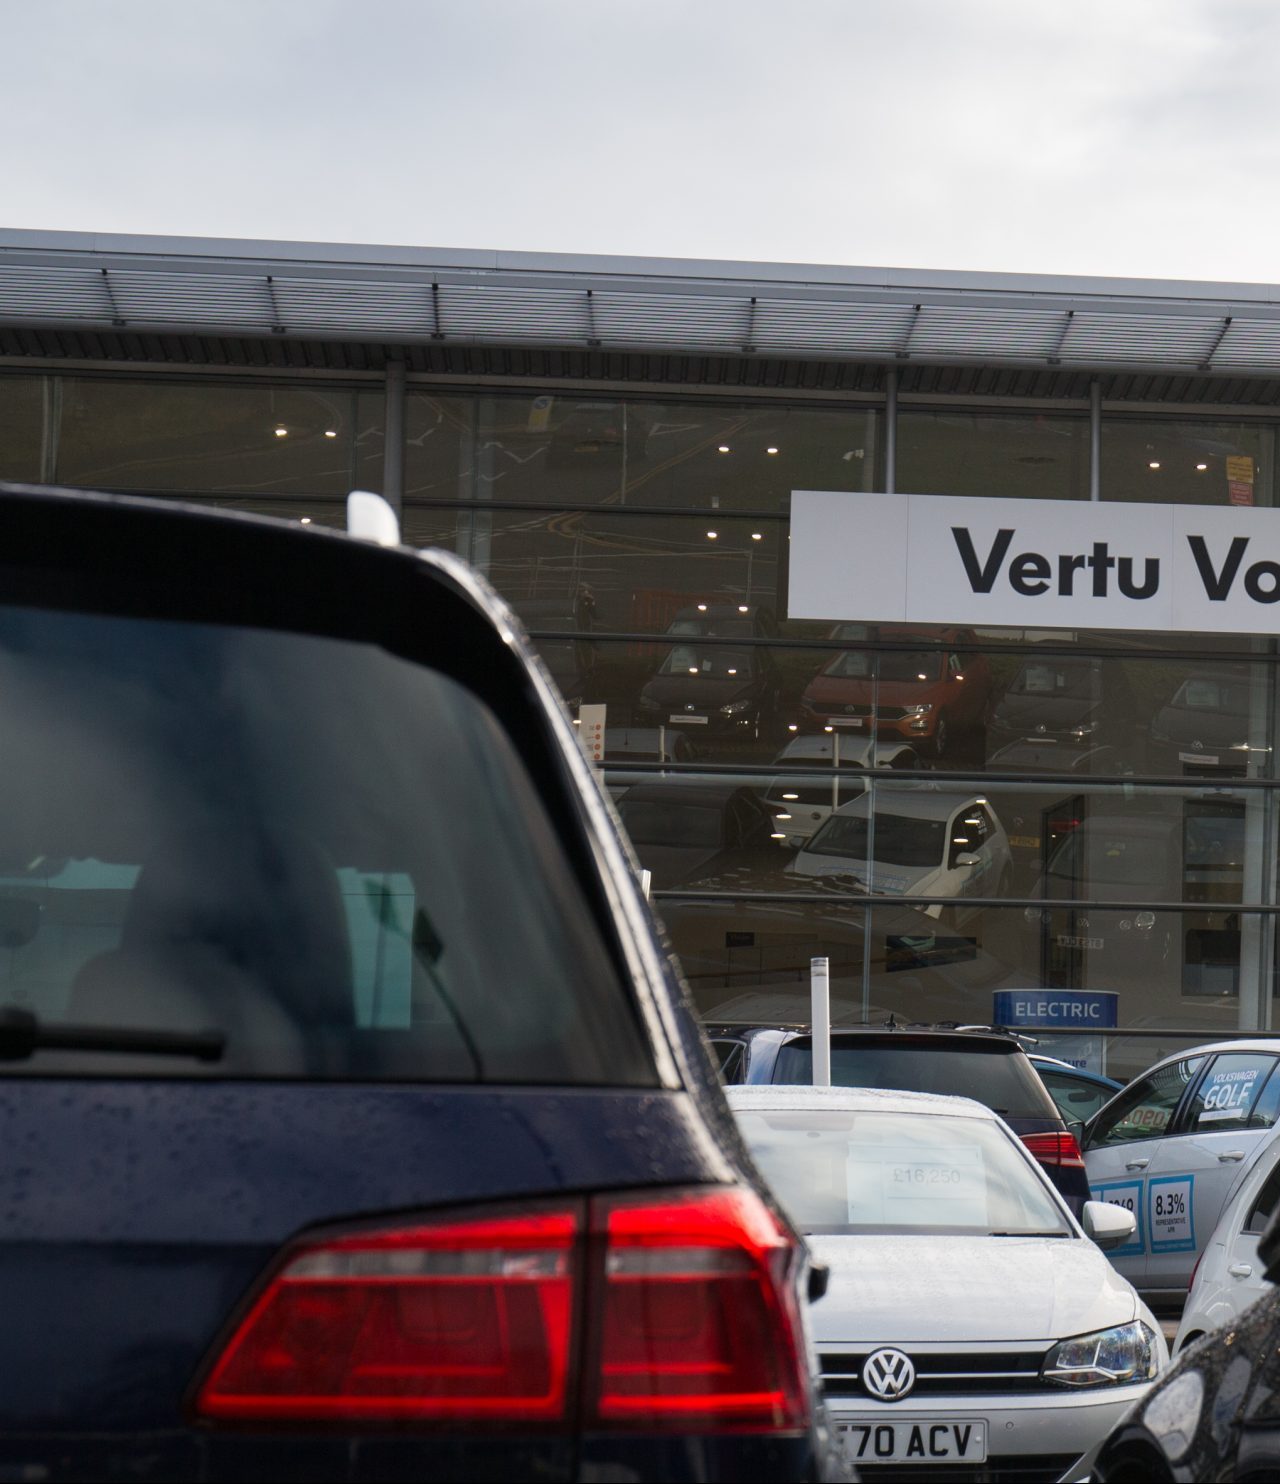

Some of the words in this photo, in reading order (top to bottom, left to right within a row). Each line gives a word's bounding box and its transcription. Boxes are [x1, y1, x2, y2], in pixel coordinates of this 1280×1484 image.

[951, 527, 1160, 600] Vertu
[1015, 1002, 1100, 1018] ELECTRIC
[1213, 1070, 1259, 1083] VOLKSWAGEN
[1204, 1082, 1253, 1110] GOLF
[893, 1168, 961, 1185] £16,250
[1155, 1193, 1185, 1216] 8.3%
[906, 1425, 972, 1457] ACV
